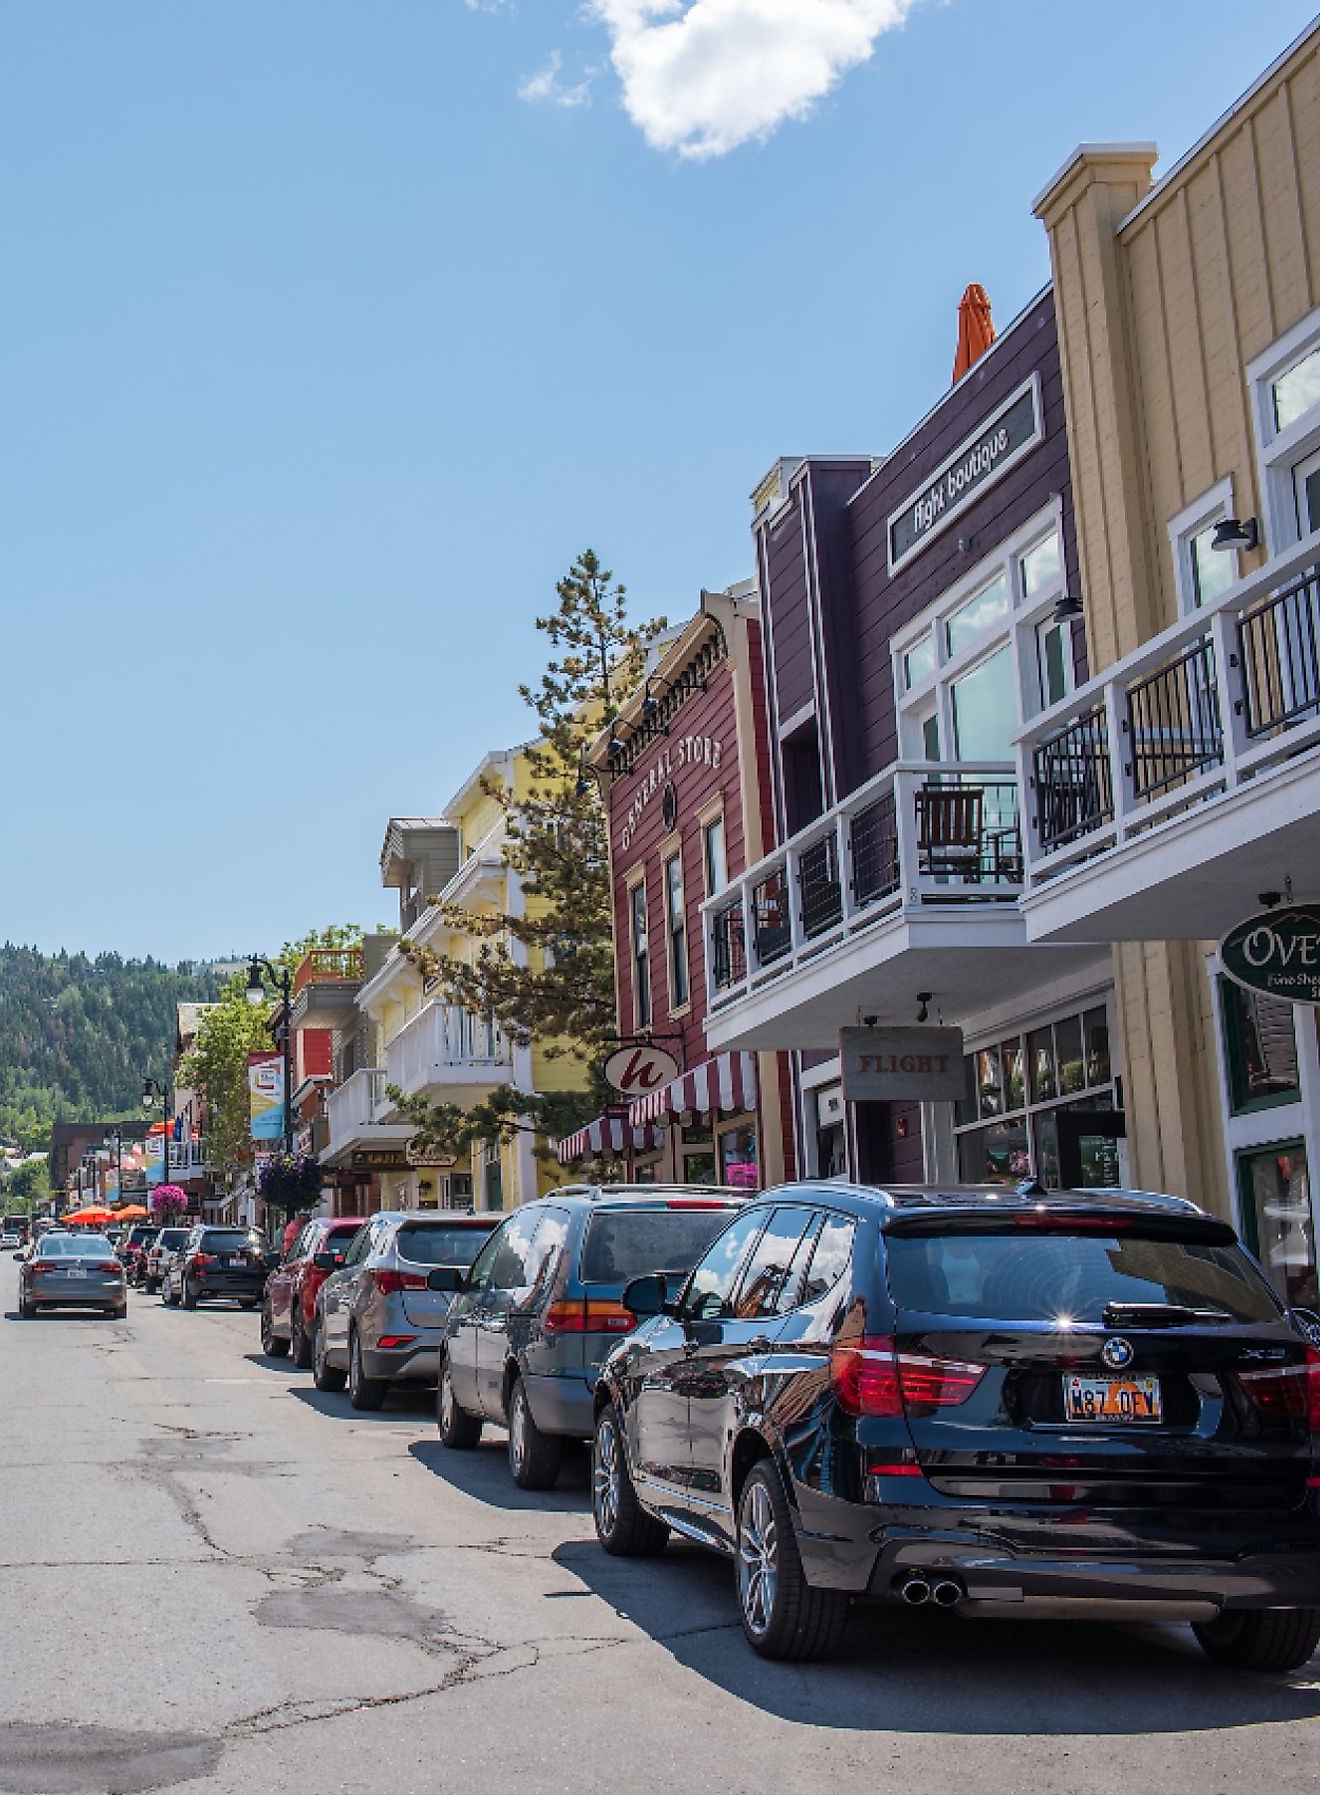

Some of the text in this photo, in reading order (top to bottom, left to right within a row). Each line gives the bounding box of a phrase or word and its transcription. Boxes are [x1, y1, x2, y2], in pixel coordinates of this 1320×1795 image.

[914, 428, 1008, 534] flight boutique
[621, 735, 723, 851] GENERAL STORE
[1244, 927, 1320, 967] OVE
[620, 1048, 664, 1090] h
[859, 1055, 950, 1074] FLIGHT
